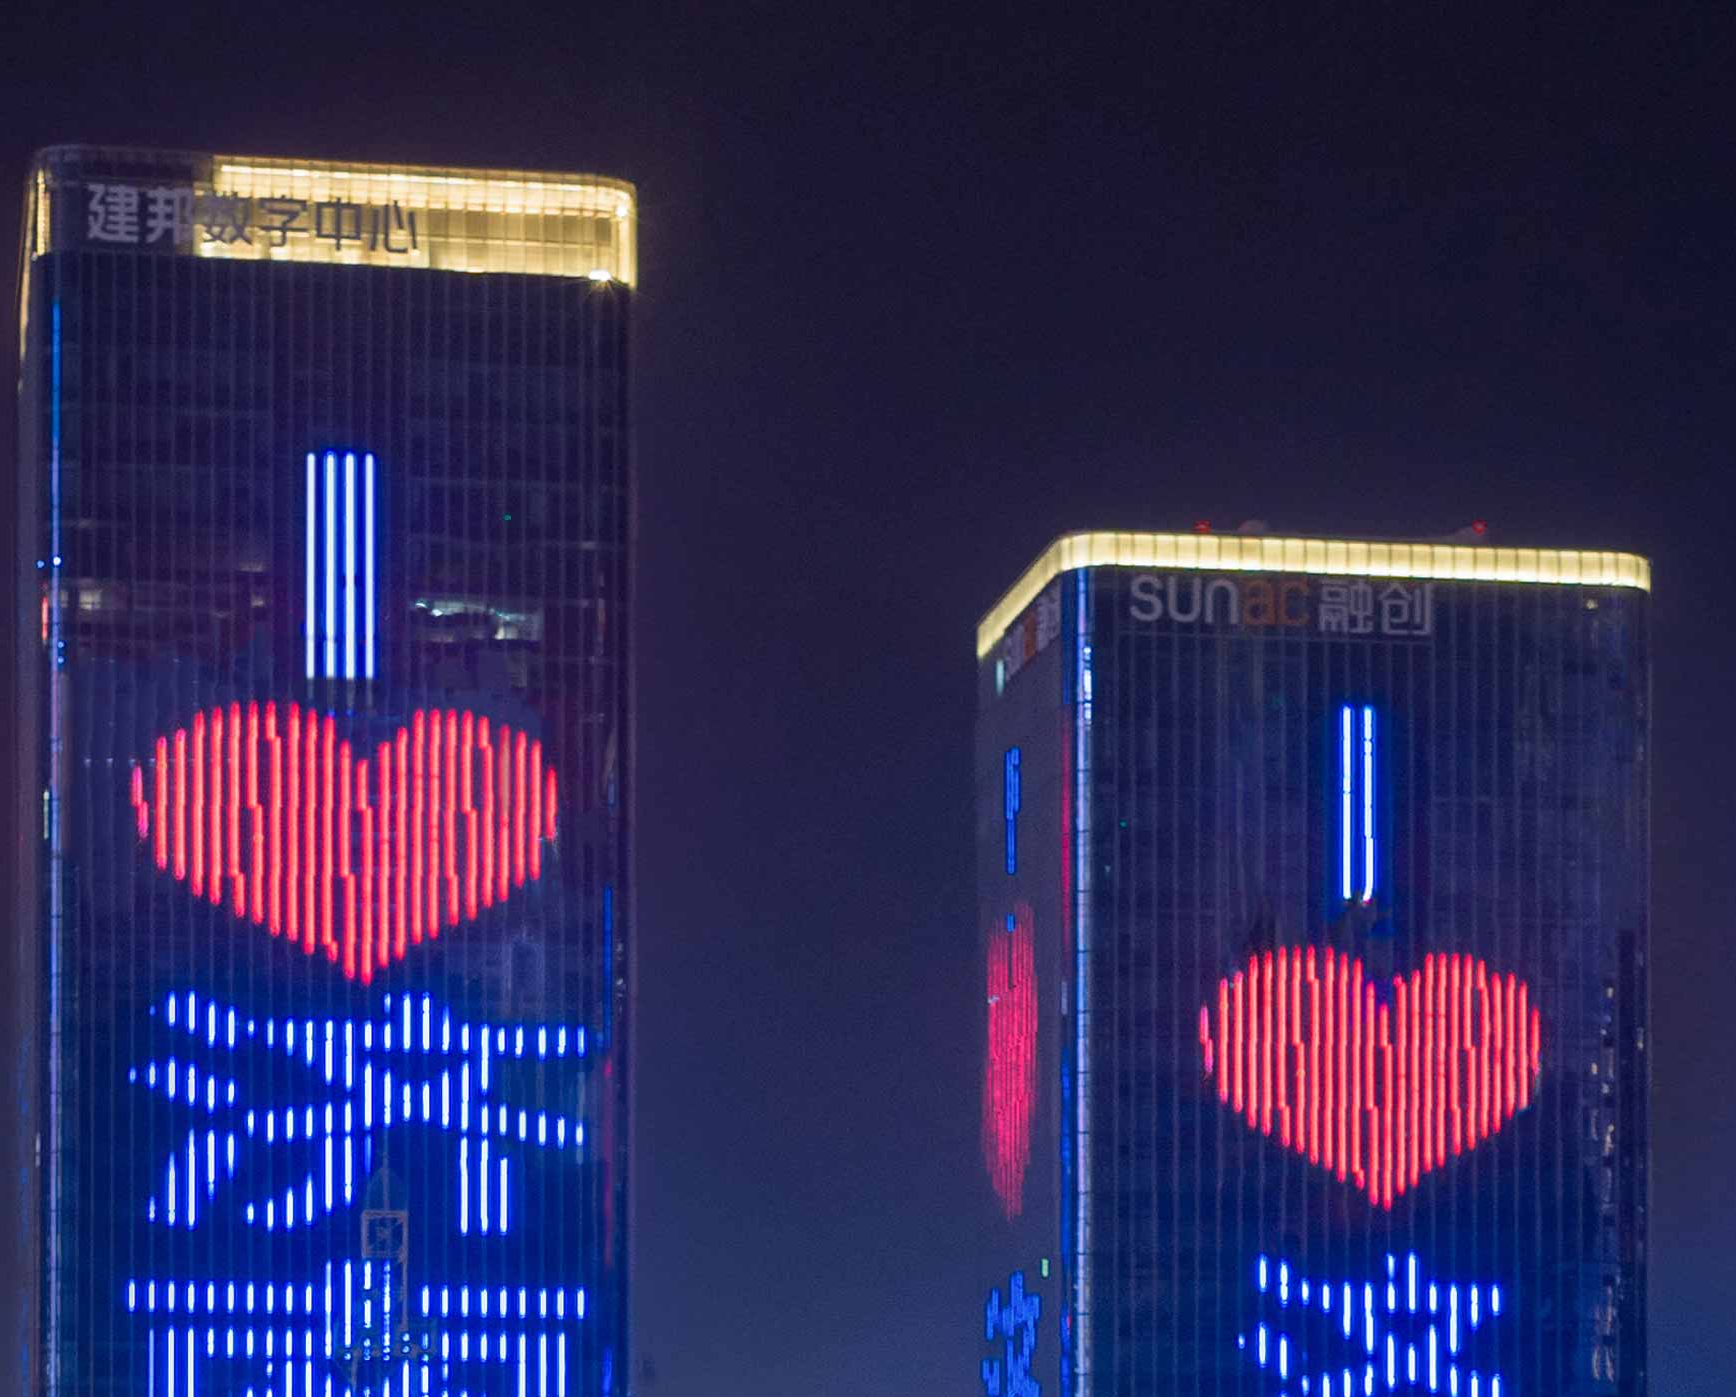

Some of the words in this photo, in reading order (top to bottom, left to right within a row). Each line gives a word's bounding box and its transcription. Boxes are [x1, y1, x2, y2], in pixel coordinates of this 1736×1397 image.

[88, 182, 418, 254] 建邦数字中心
[1318, 580, 1435, 637] 融创
